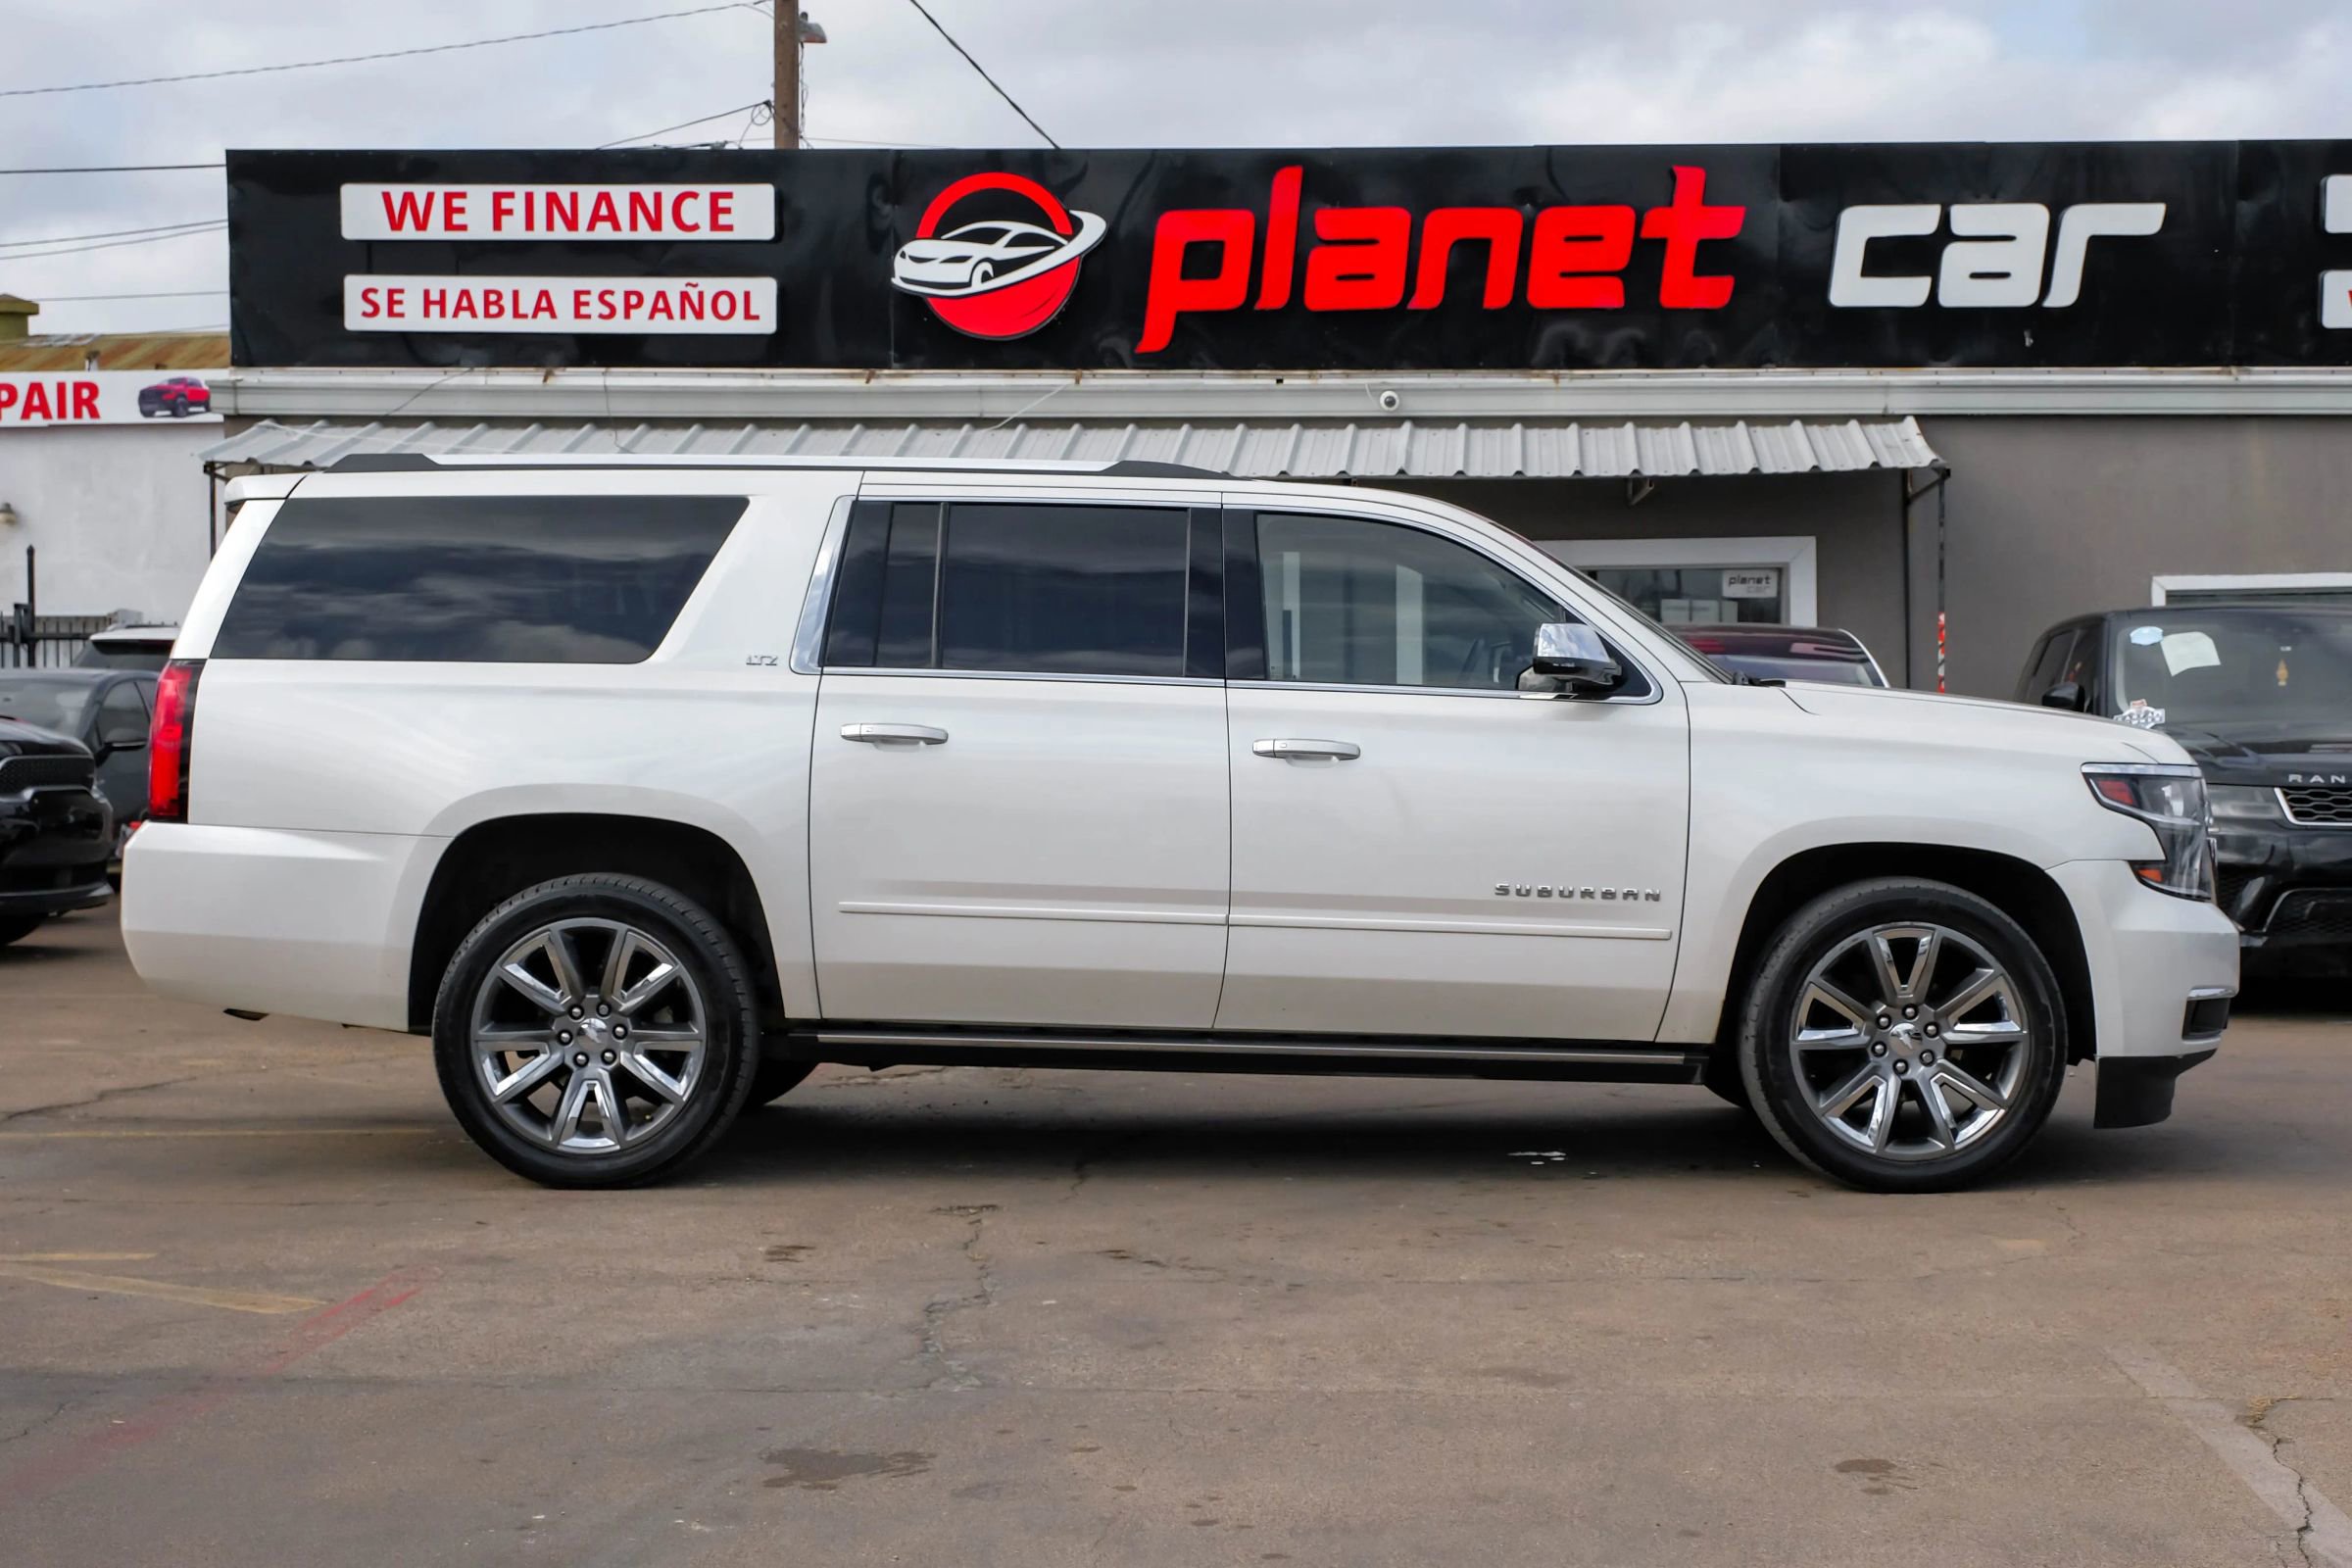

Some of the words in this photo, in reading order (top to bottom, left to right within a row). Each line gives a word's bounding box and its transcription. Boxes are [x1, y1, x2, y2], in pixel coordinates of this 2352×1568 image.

[381, 190, 468, 232] WE
[492, 190, 735, 233] FINANCE
[1134, 165, 1748, 354] planet
[1829, 202, 2167, 308] car
[361, 286, 406, 318] SE
[422, 287, 558, 320] HABLA
[572, 281, 760, 321] ESPAÑOL
[1728, 574, 1771, 587] planet
[2288, 773, 2346, 784] RAN
[1494, 883, 1661, 903] SUBURBAN
